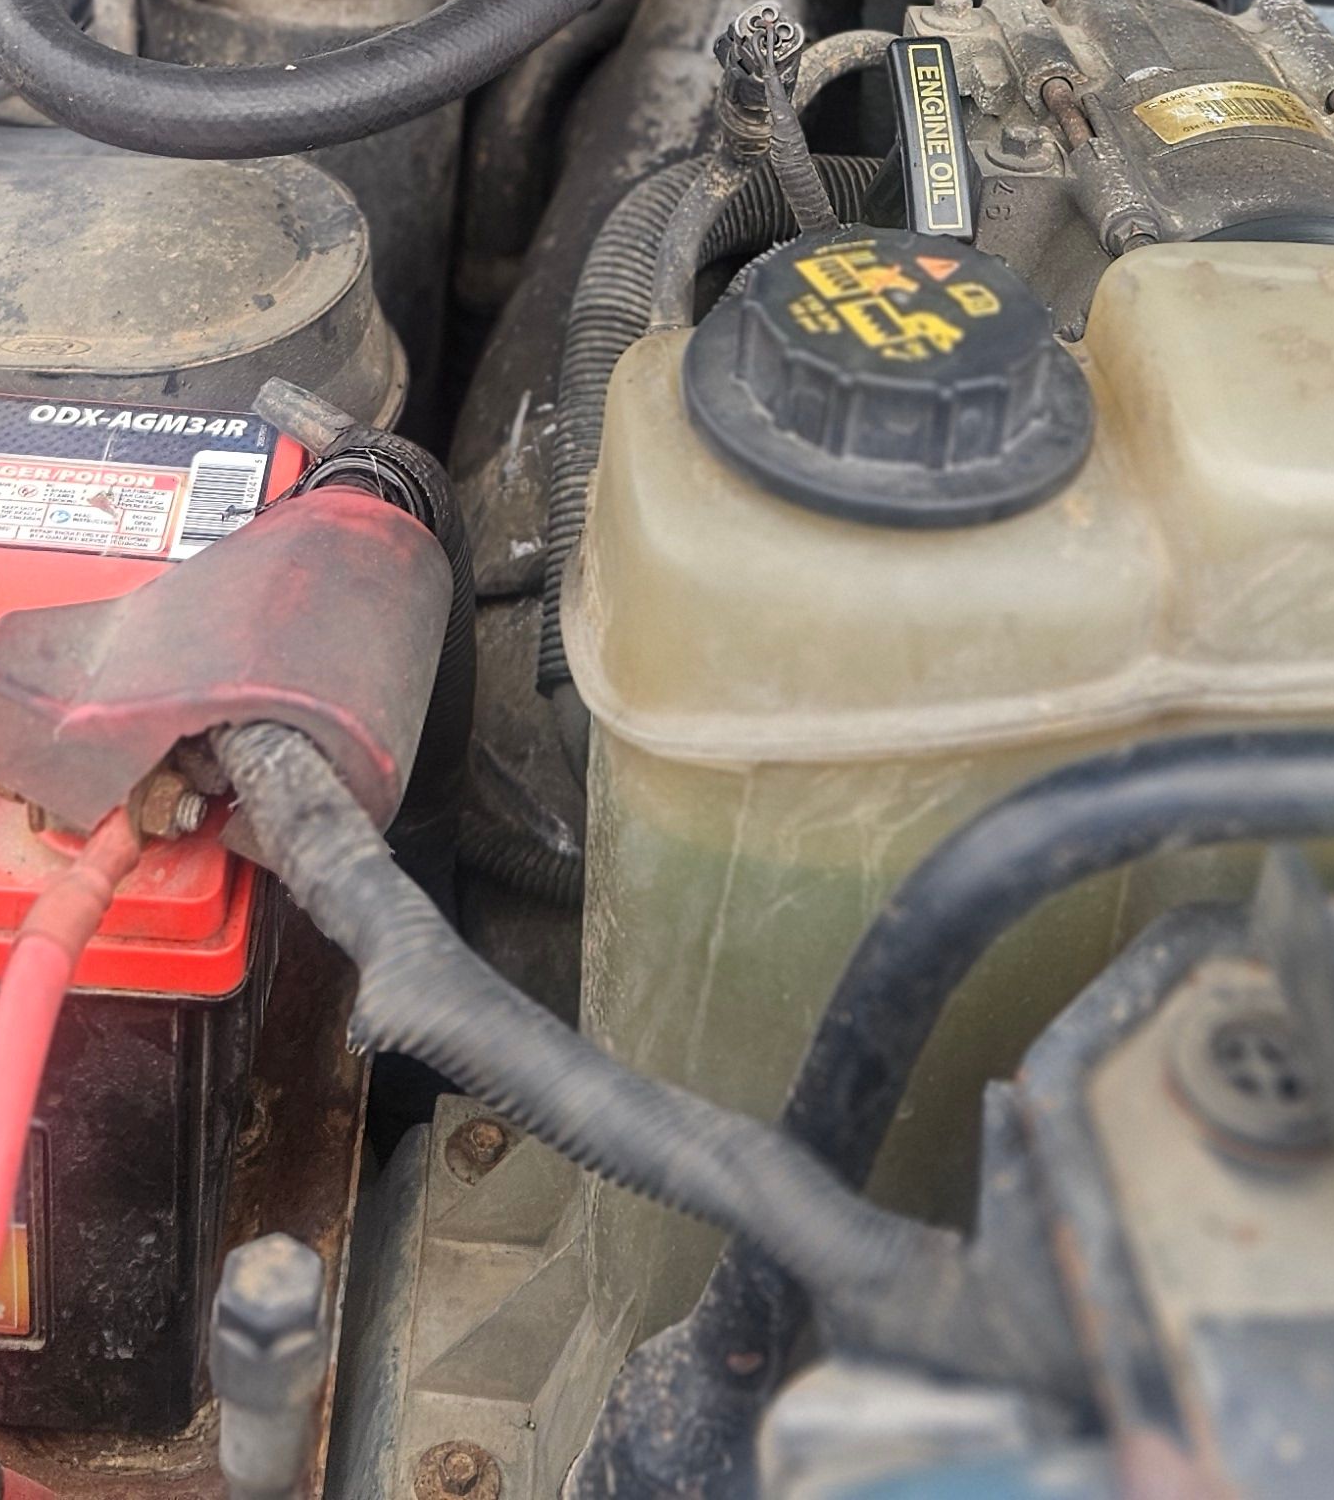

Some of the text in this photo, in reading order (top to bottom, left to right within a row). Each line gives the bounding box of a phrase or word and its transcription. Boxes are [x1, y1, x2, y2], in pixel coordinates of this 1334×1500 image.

[916, 66, 955, 205] ENGINE OIL
[28, 403, 249, 438] ODX-AGM34R
[244, 475, 260, 505] 14041
